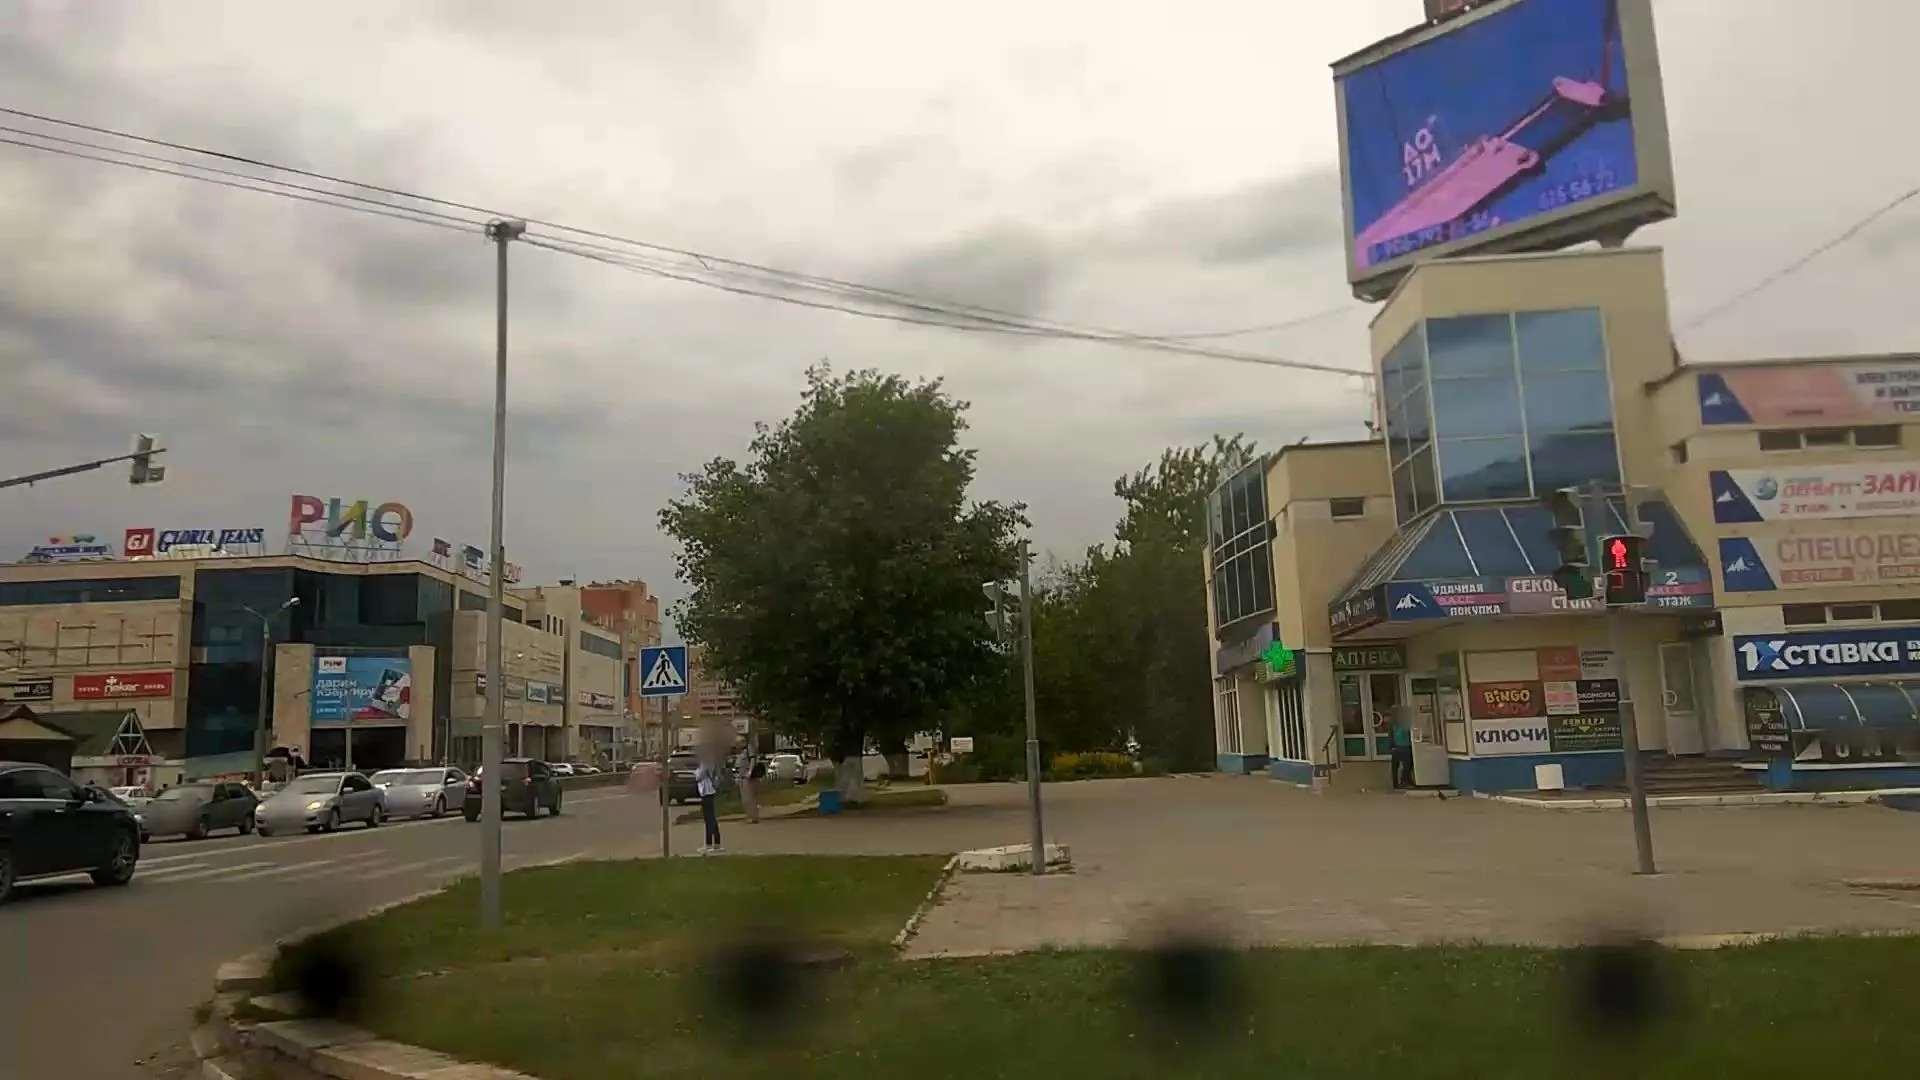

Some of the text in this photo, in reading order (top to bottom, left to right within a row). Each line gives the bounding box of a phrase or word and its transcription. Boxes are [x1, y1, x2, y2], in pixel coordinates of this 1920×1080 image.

[292, 495, 413, 542] РИО
[1777, 533, 1920, 566] СПЕЦОДЕ
[1665, 571, 1680, 585] 2
[1432, 583, 1484, 595] УДАЧНАЯ
[1450, 605, 1501, 616] ПОКУПКА
[1335, 650, 1401, 665] АПТЕКА
[1476, 728, 1547, 743] КЛЮЧИ
